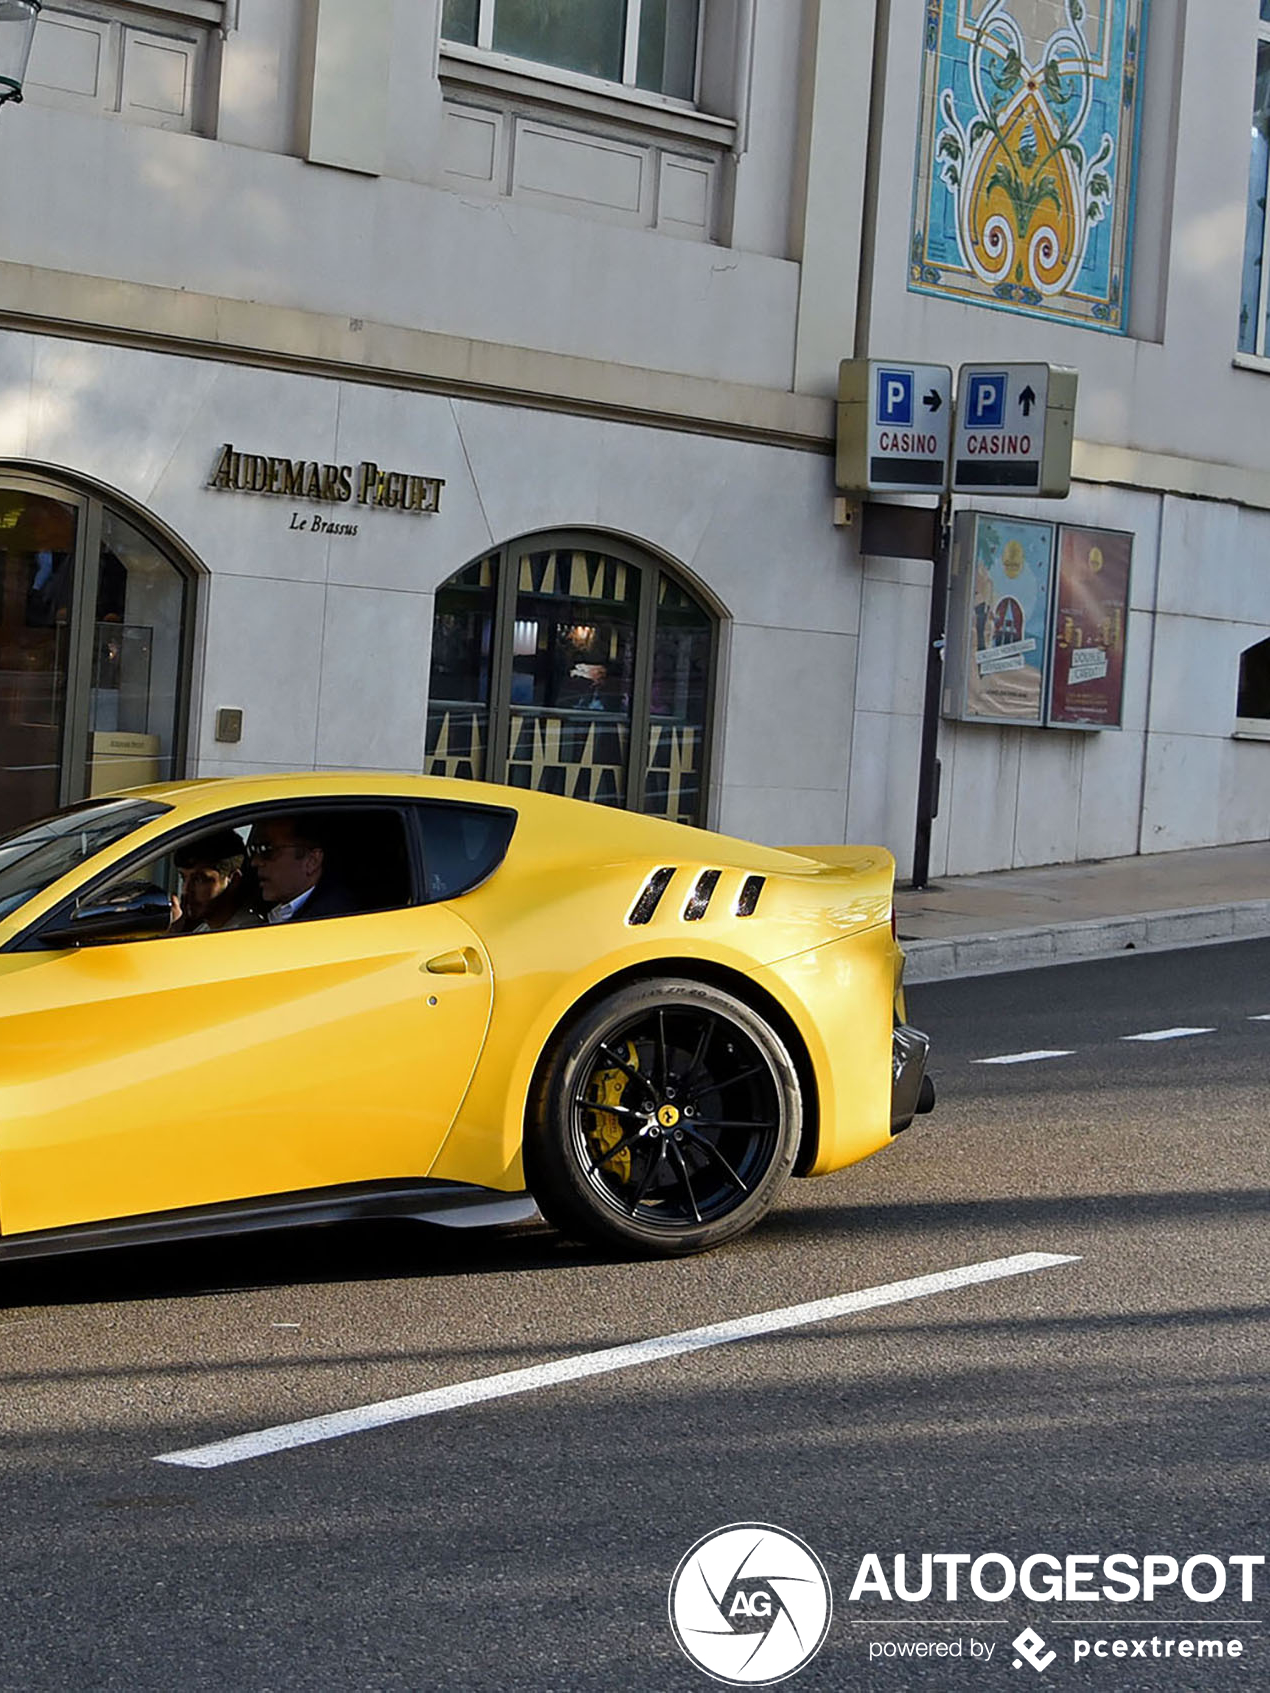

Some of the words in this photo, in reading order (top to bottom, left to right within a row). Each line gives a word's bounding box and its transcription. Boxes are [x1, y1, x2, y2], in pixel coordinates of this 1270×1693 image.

[887, 381, 905, 414] P
[977, 384, 996, 416] P
[880, 432, 937, 454] CASINO
[967, 435, 1031, 455] CASINO
[209, 444, 352, 502] AUDEMARS
[357, 461, 446, 514] PIGUET
[290, 512, 307, 531] Le
[311, 514, 359, 536] Brassus
